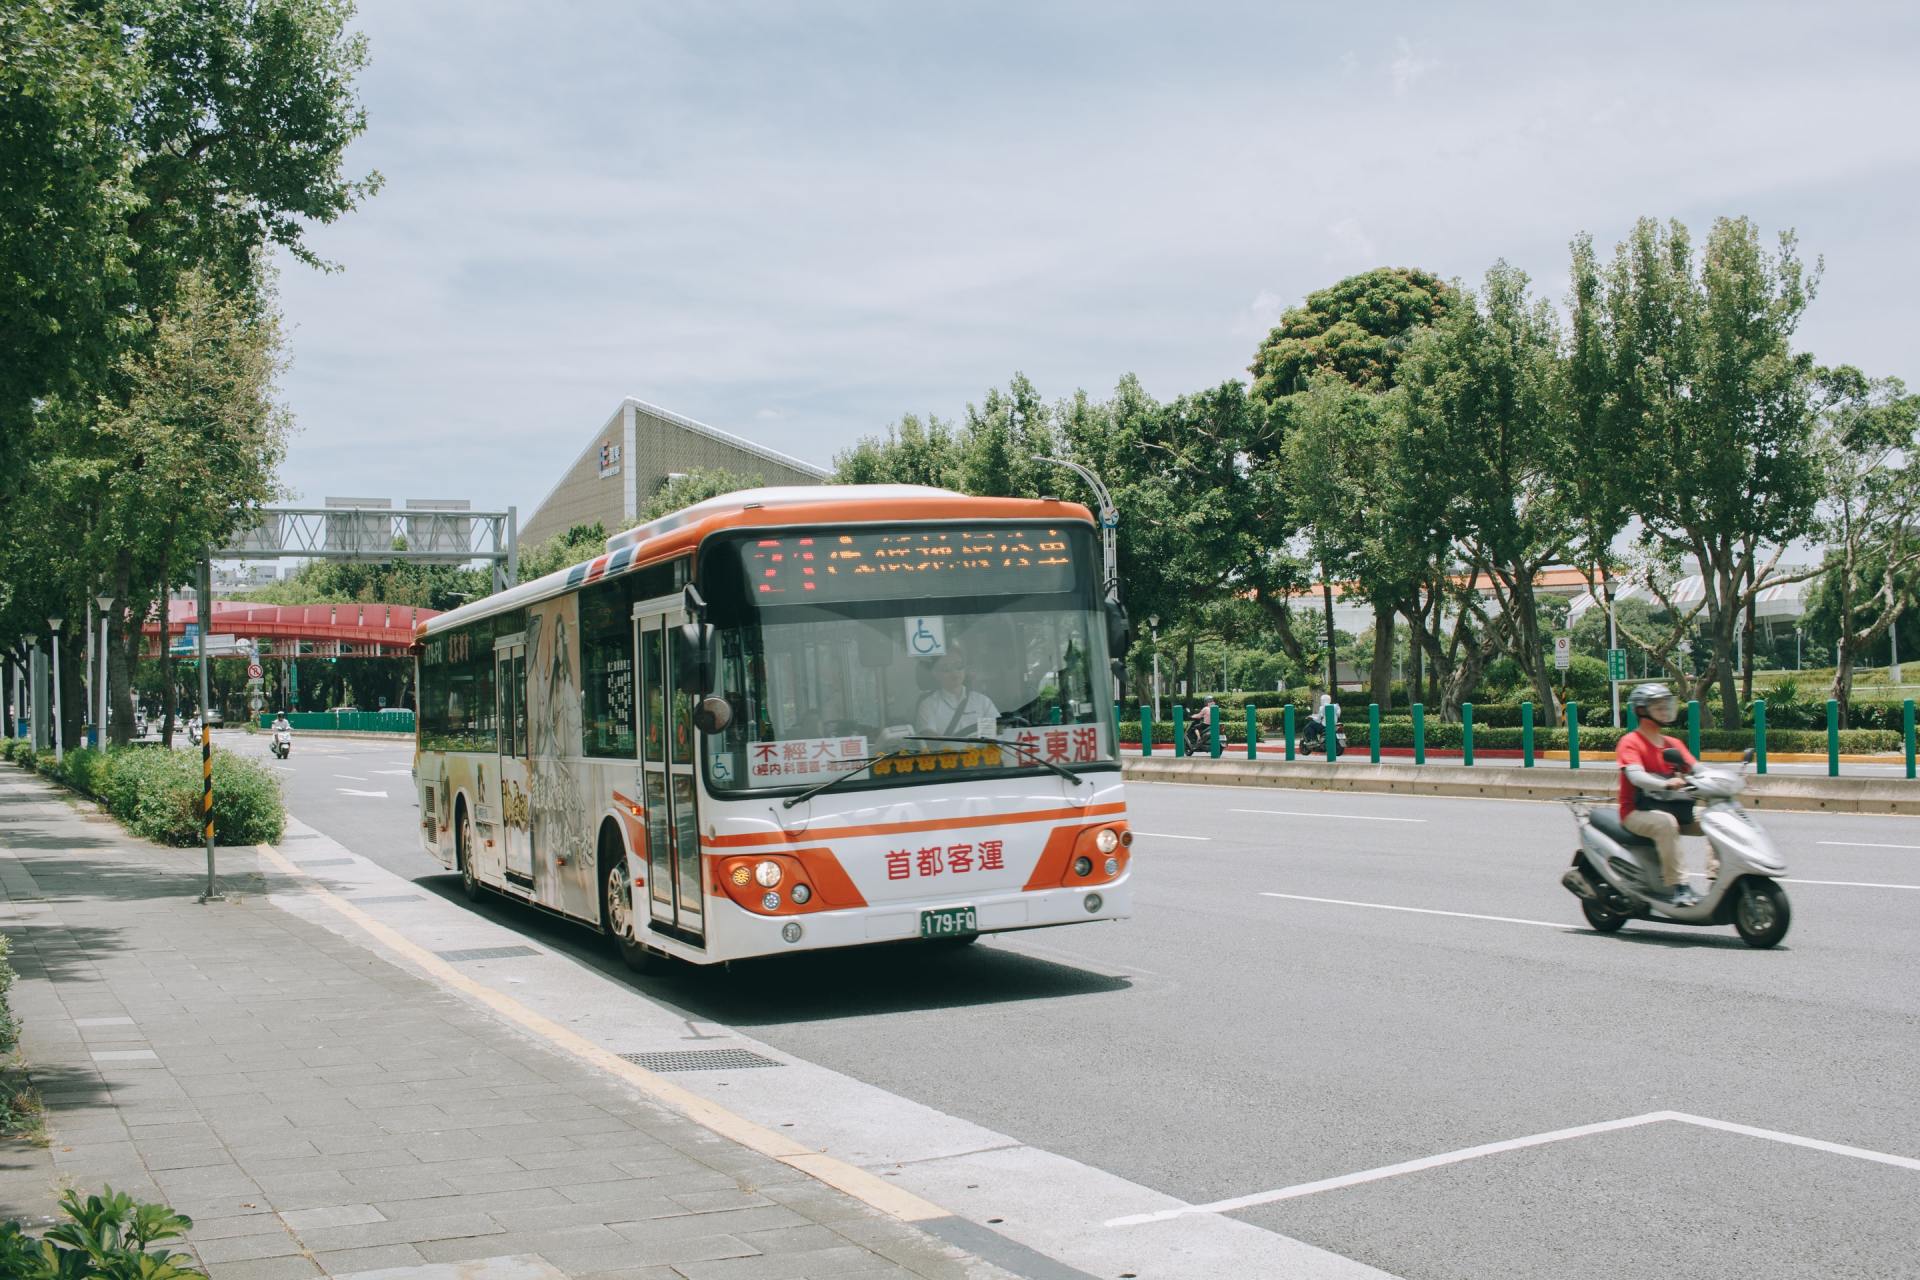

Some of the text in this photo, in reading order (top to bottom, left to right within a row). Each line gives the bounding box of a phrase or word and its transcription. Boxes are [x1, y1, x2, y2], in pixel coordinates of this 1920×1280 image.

[753, 739, 865, 763] 不經大直
[884, 840, 1005, 881] 首都客運
